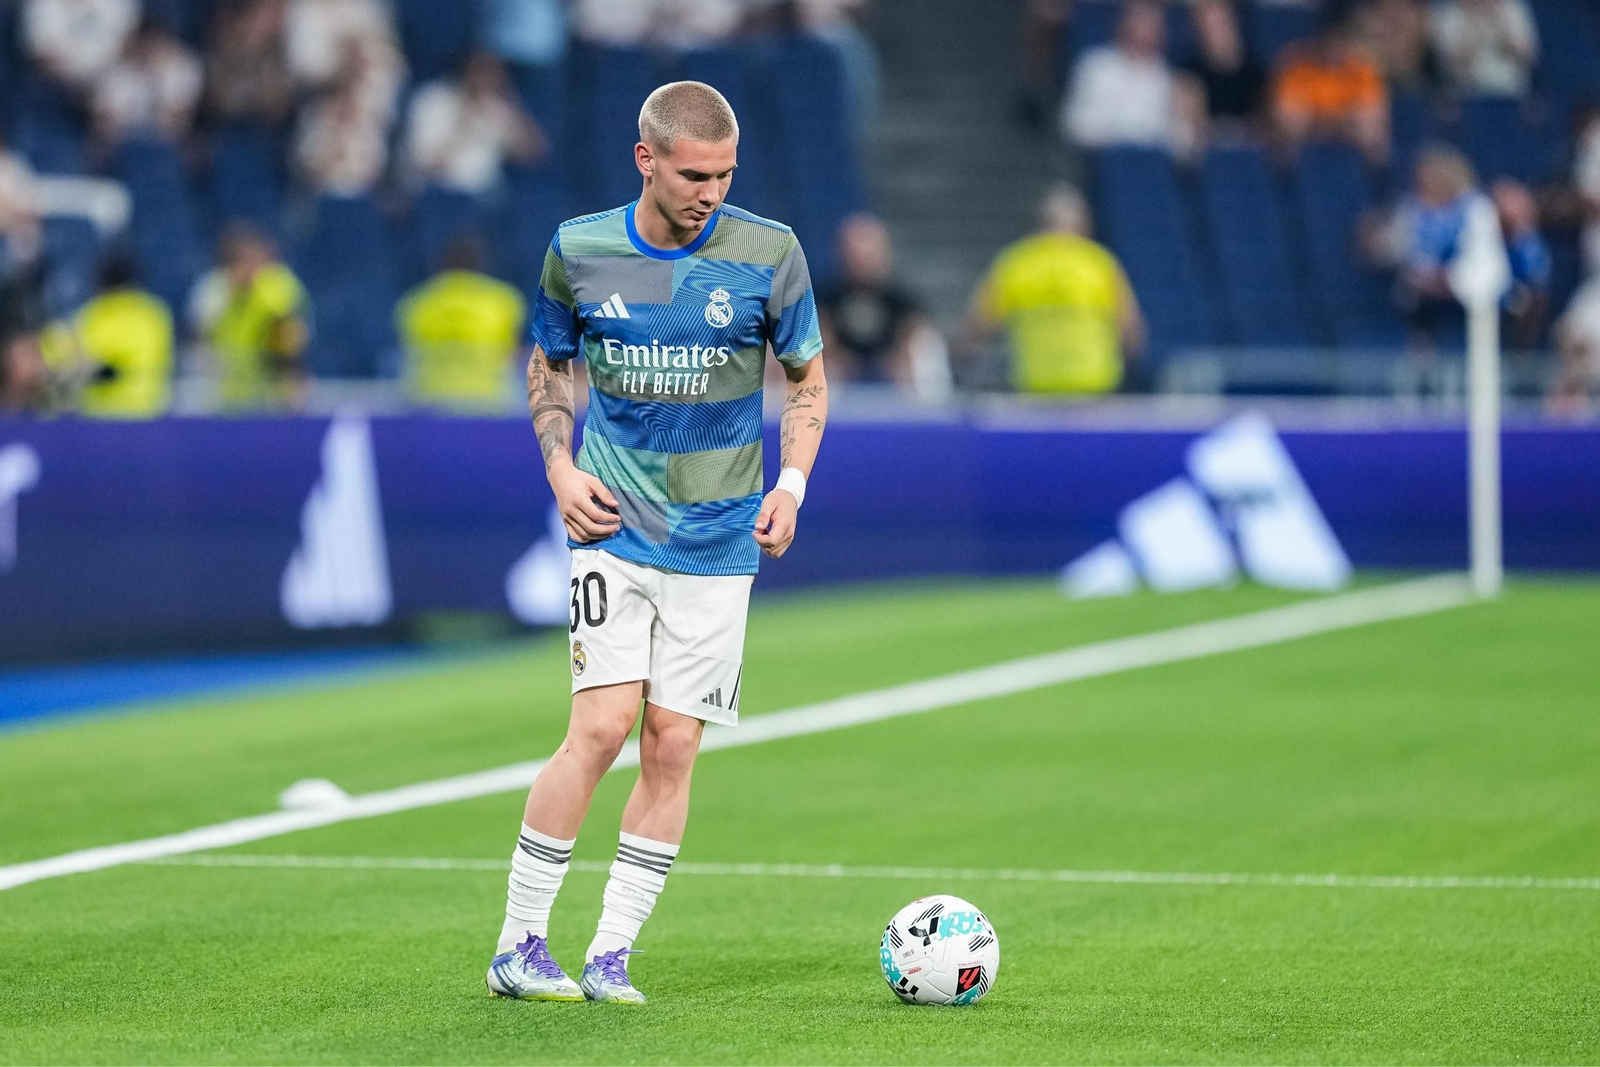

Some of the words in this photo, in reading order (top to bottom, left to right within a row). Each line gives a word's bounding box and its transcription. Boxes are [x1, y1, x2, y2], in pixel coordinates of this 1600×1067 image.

[603, 338, 729, 368] Emirates
[622, 371, 649, 394] FLY
[653, 373, 710, 395] BETTER
[570, 571, 608, 634] 30
